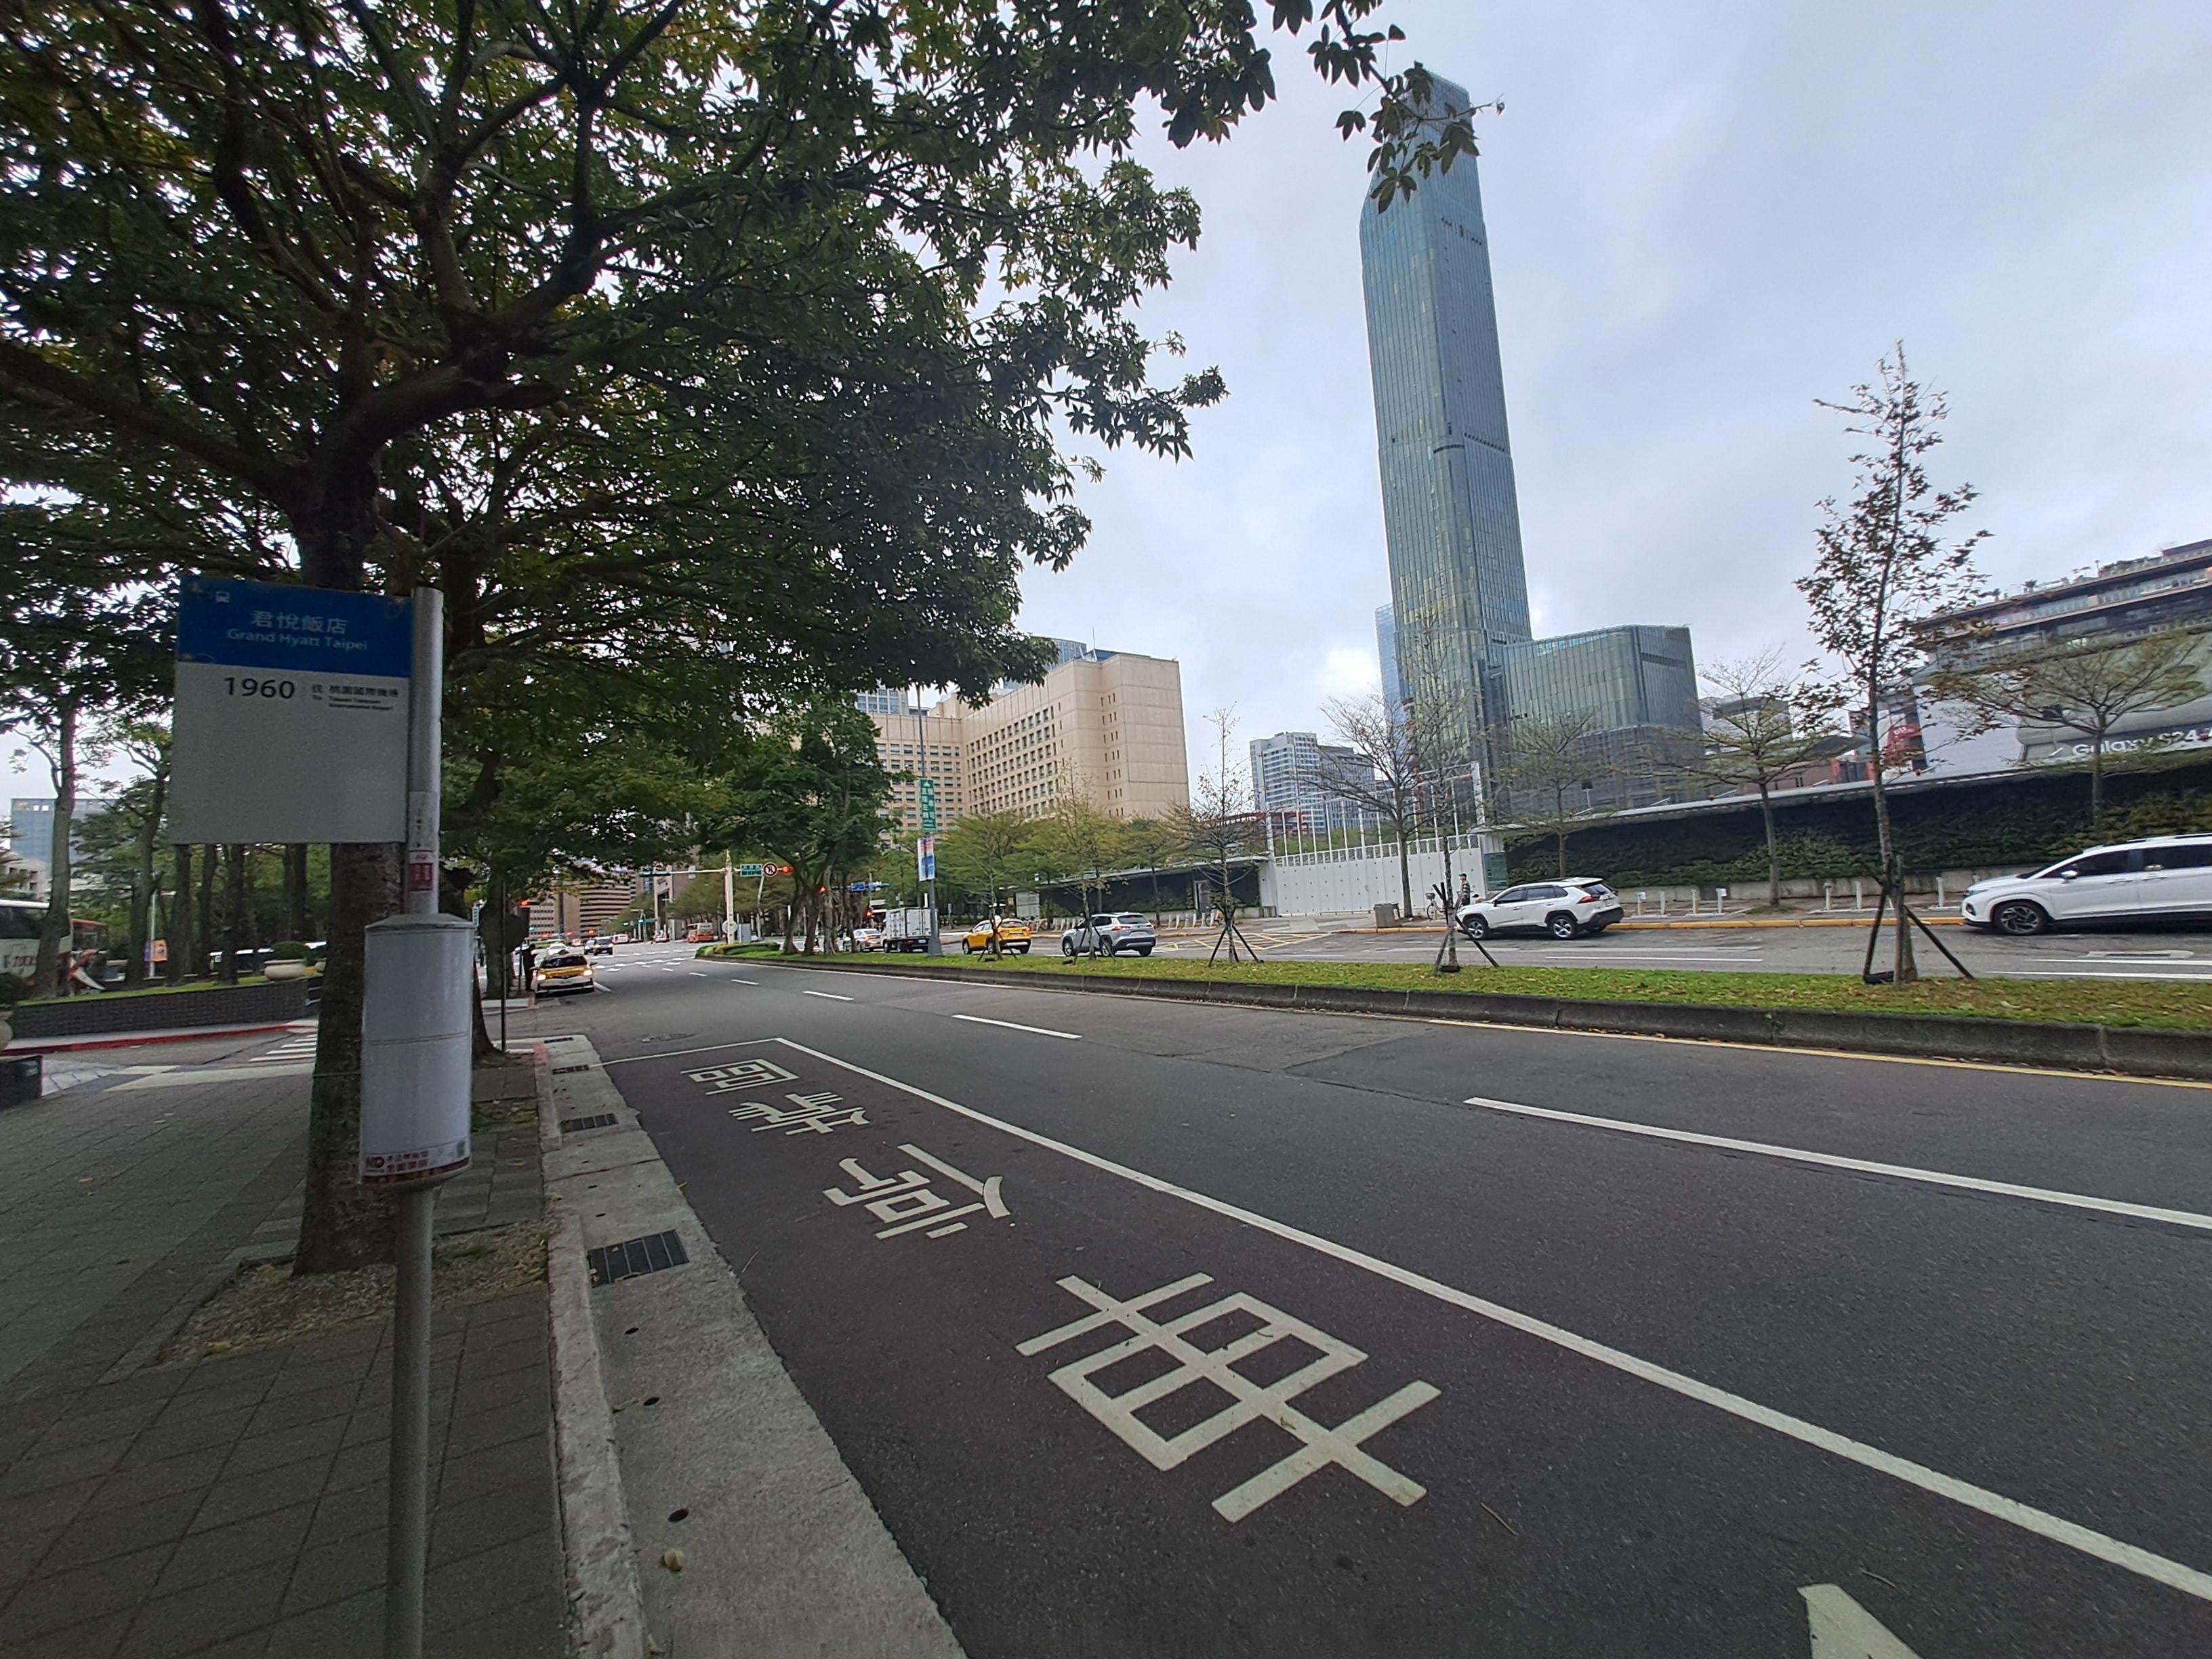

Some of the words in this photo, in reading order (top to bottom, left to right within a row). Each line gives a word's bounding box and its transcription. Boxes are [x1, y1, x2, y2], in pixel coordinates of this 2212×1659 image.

[251, 609, 348, 635] 君悅飯店
[228, 628, 274, 644] Grand
[279, 632, 320, 648] Hyatt
[324, 636, 368, 651] Taipei
[224, 677, 295, 699] 1960
